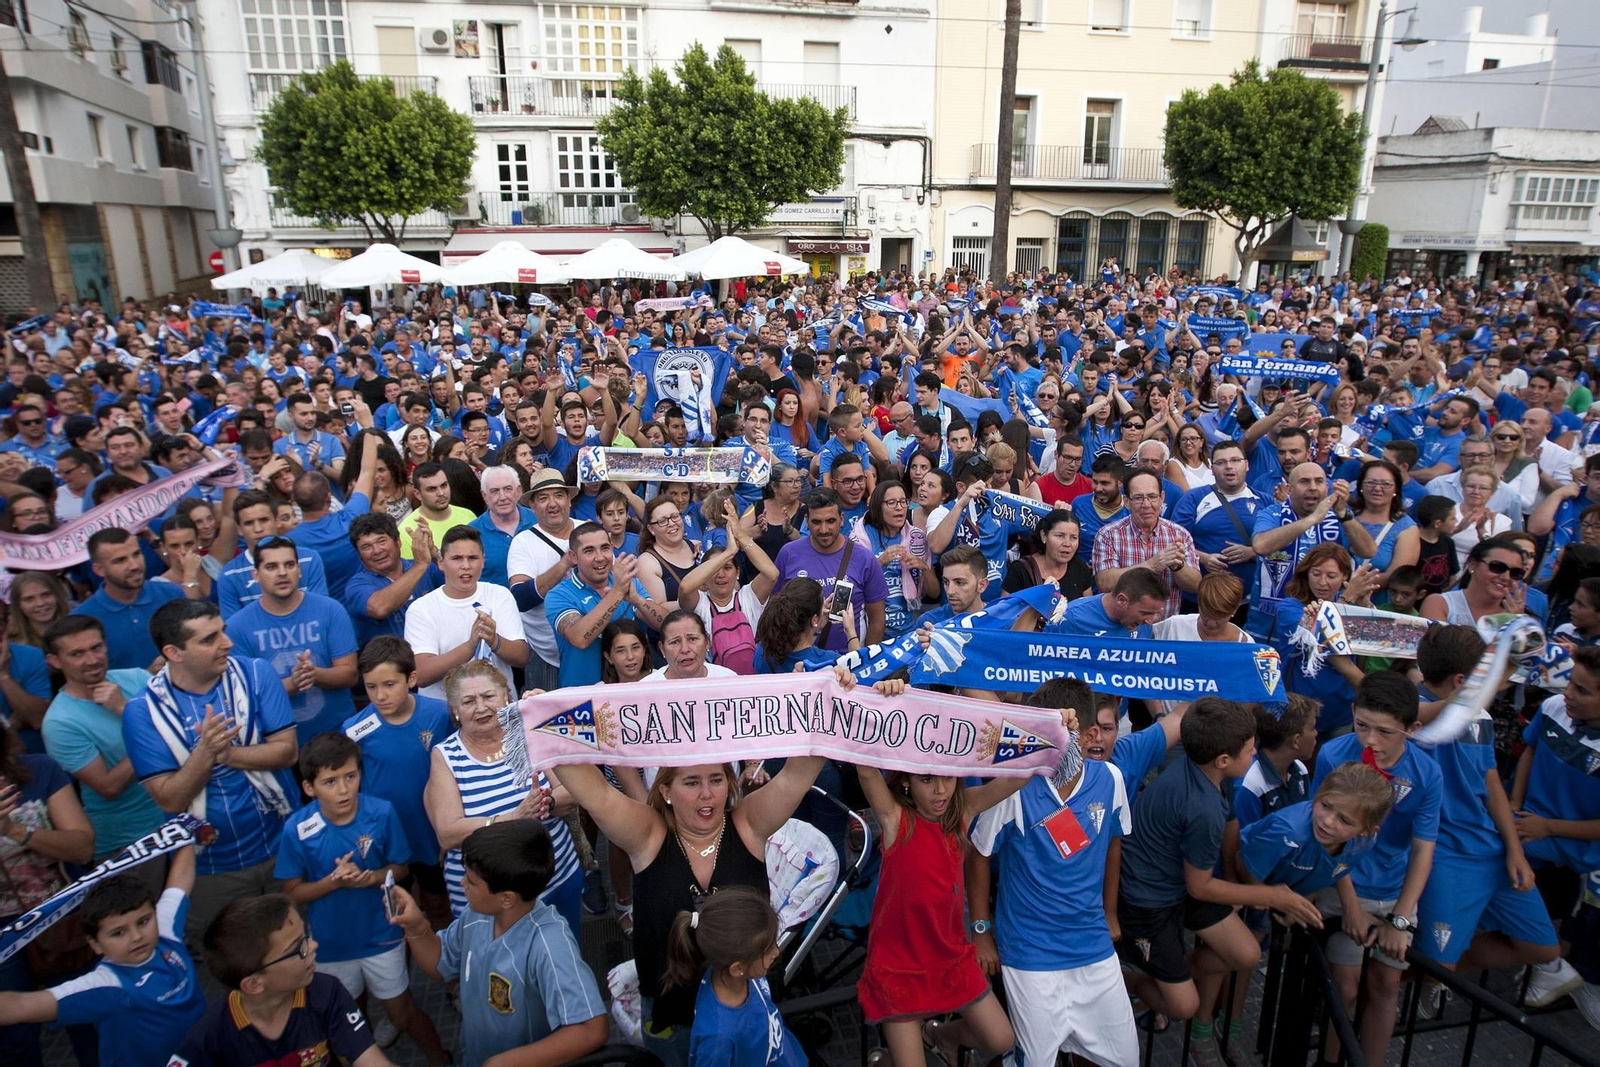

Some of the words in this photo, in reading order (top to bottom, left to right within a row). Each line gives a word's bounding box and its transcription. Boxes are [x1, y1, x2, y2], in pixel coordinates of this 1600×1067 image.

[846, 243, 863, 251] ISLA
[617, 268, 678, 281] Cruzcampo
[1221, 356, 1252, 368] San
[1255, 357, 1338, 376] Fernando
[1264, 369, 1320, 379] DEPORTIVO
[254, 620, 321, 651] TOXIC
[1028, 643, 1092, 661] MAREA
[1096, 648, 1178, 665] AZULINA
[1083, 672, 1107, 686] LA
[1111, 673, 1219, 693] CONQUISTA
[619, 700, 697, 746] SAN
[705, 690, 910, 749] FERNANDO
[914, 714, 976, 757] C.D
